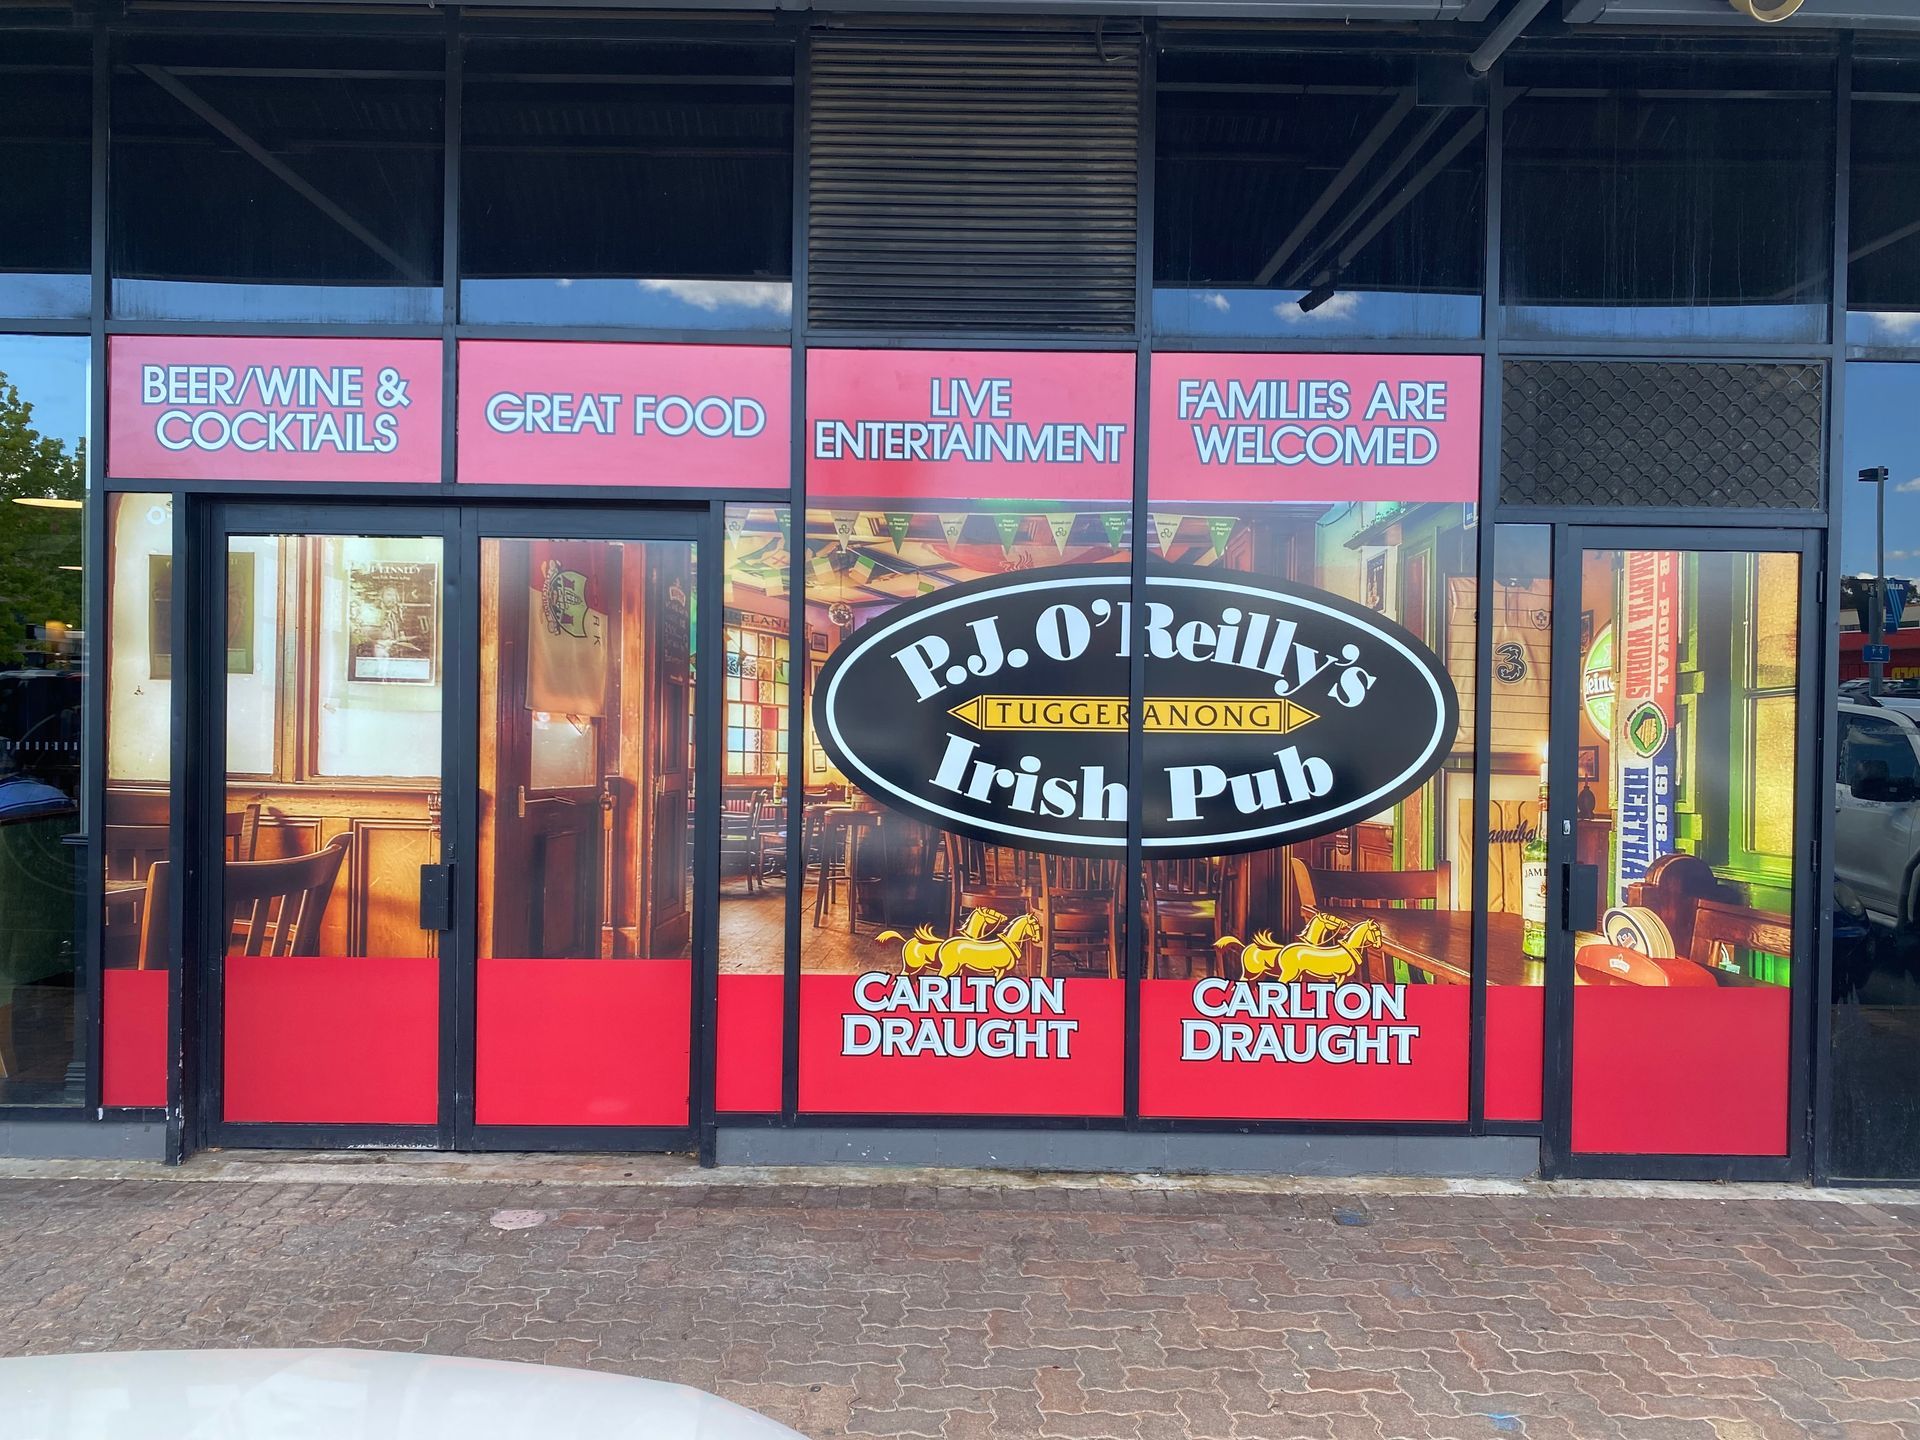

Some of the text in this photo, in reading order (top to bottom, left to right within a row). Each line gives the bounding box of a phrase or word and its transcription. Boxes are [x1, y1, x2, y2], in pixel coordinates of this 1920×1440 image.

[141, 363, 412, 409] BEER/WINE &
[930, 377, 1012, 418] LIVE
[1178, 379, 1447, 421] FAMILIES ARE
[155, 409, 398, 453] COCKTAILS
[485, 391, 767, 438] GREAT FOOD
[814, 420, 1127, 463] ENTERTAINMENT
[1192, 424, 1440, 465] WELCOMED
[890, 599, 1377, 708] P.J. O'Reilly's
[1626, 625, 1653, 699] WORMS
[1656, 597, 1669, 693] POKAL
[996, 702, 1271, 727] TUGGERANONG
[929, 732, 1334, 822] Irish Pub
[1621, 766, 1649, 879] HERTHA
[853, 971, 1066, 1014] CARLTON
[1192, 976, 1408, 1021] CARLTON
[840, 1014, 1078, 1060] DRAUGHT
[1180, 1018, 1420, 1065] DRAUGHT
